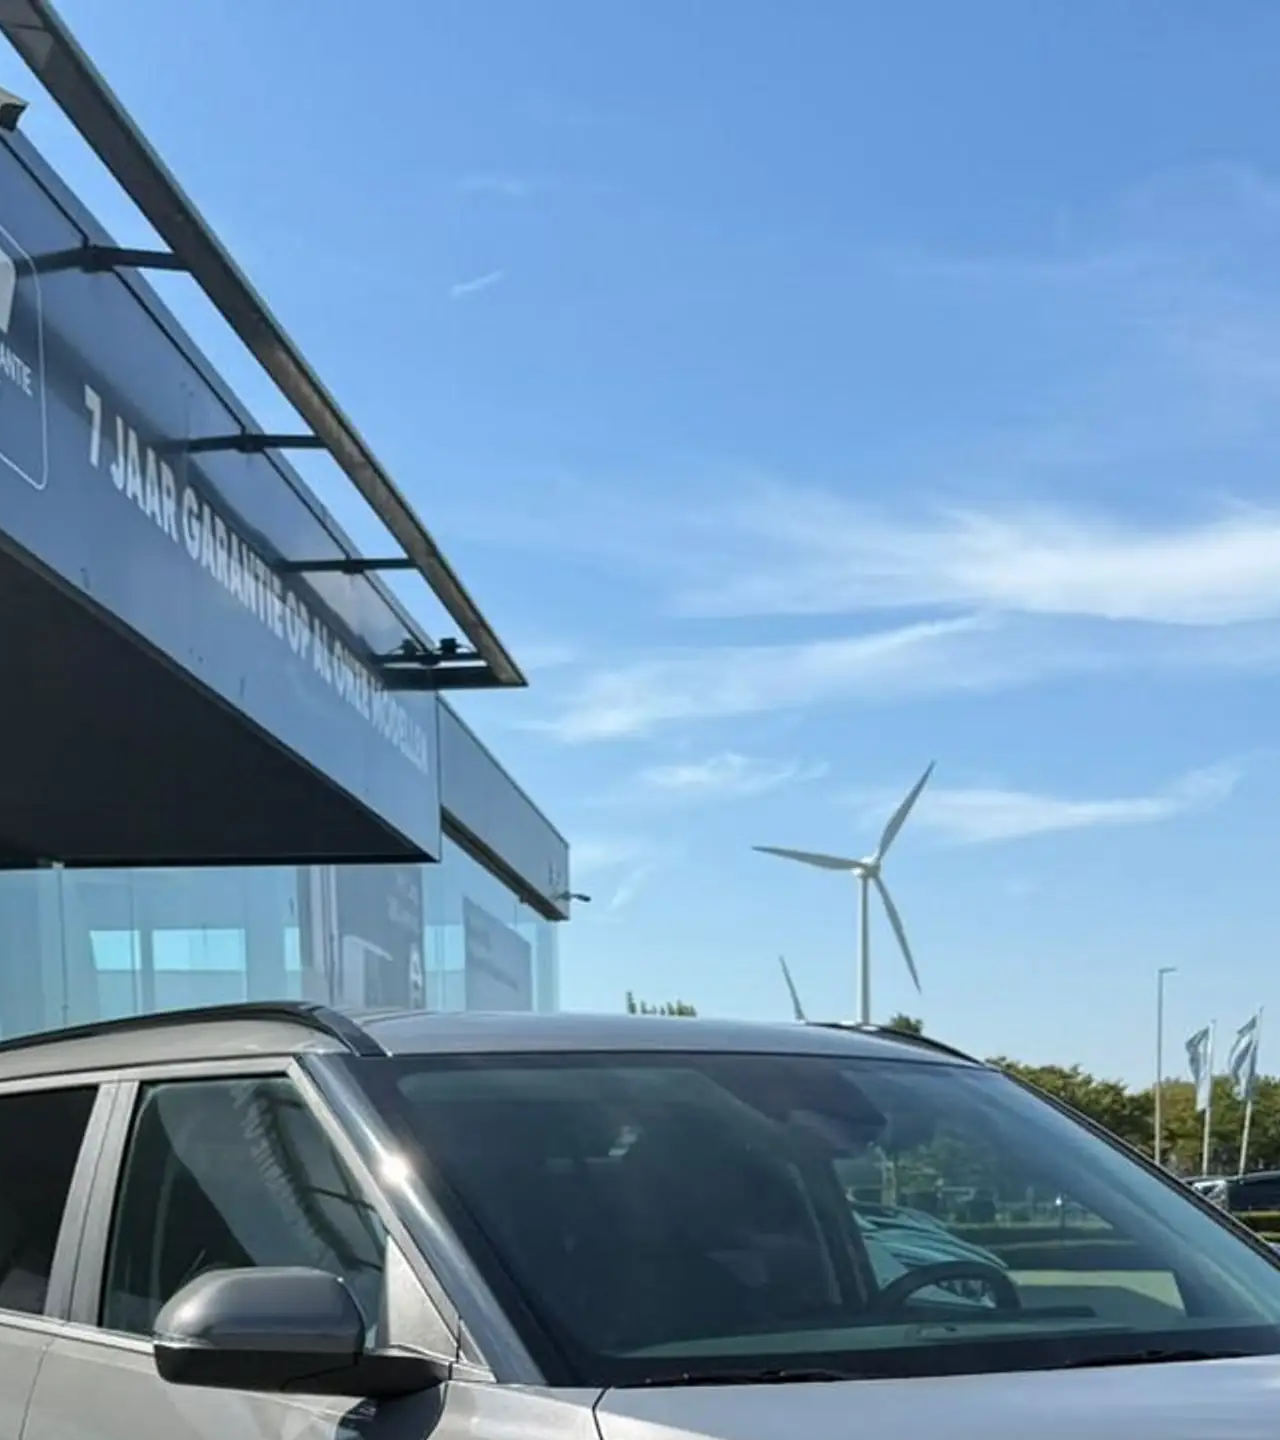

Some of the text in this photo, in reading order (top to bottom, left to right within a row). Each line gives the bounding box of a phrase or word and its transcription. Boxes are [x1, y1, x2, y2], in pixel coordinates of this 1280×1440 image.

[84, 384, 102, 469] 7
[110, 415, 179, 544] JAAR
[182, 485, 285, 640] GARANTIE
